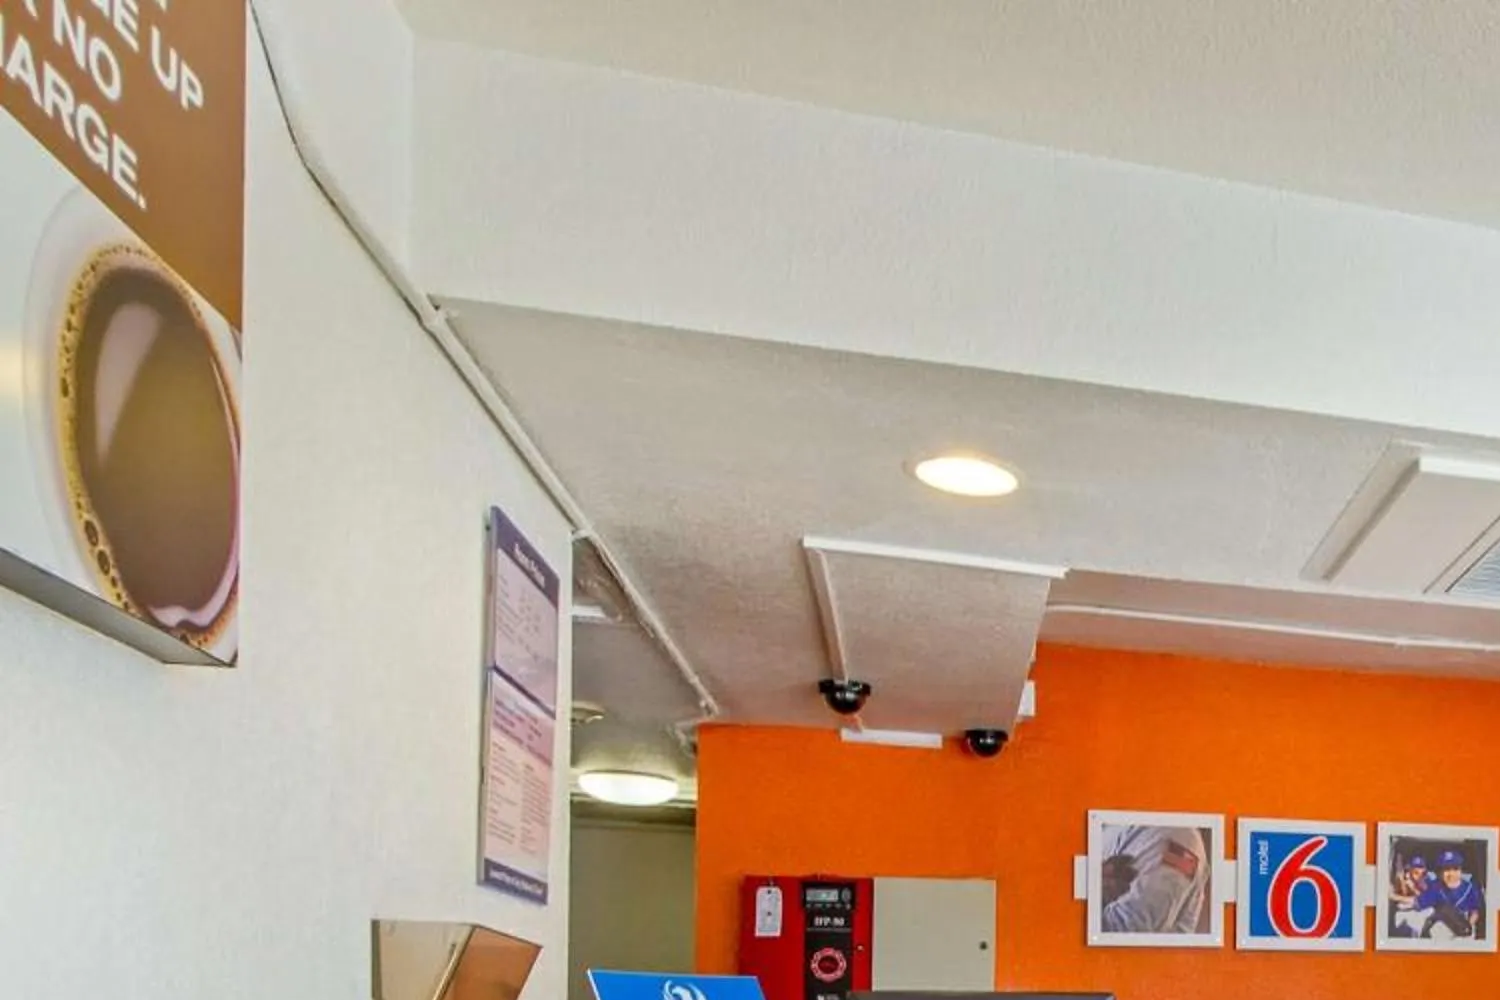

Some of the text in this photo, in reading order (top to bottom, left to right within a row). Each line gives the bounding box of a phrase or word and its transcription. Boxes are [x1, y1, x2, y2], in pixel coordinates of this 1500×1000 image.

[53, 0, 122, 101] NO
[151, 24, 204, 110] UP
[0, 13, 147, 212] ARGE.
[1257, 835, 1341, 939] motel 6
